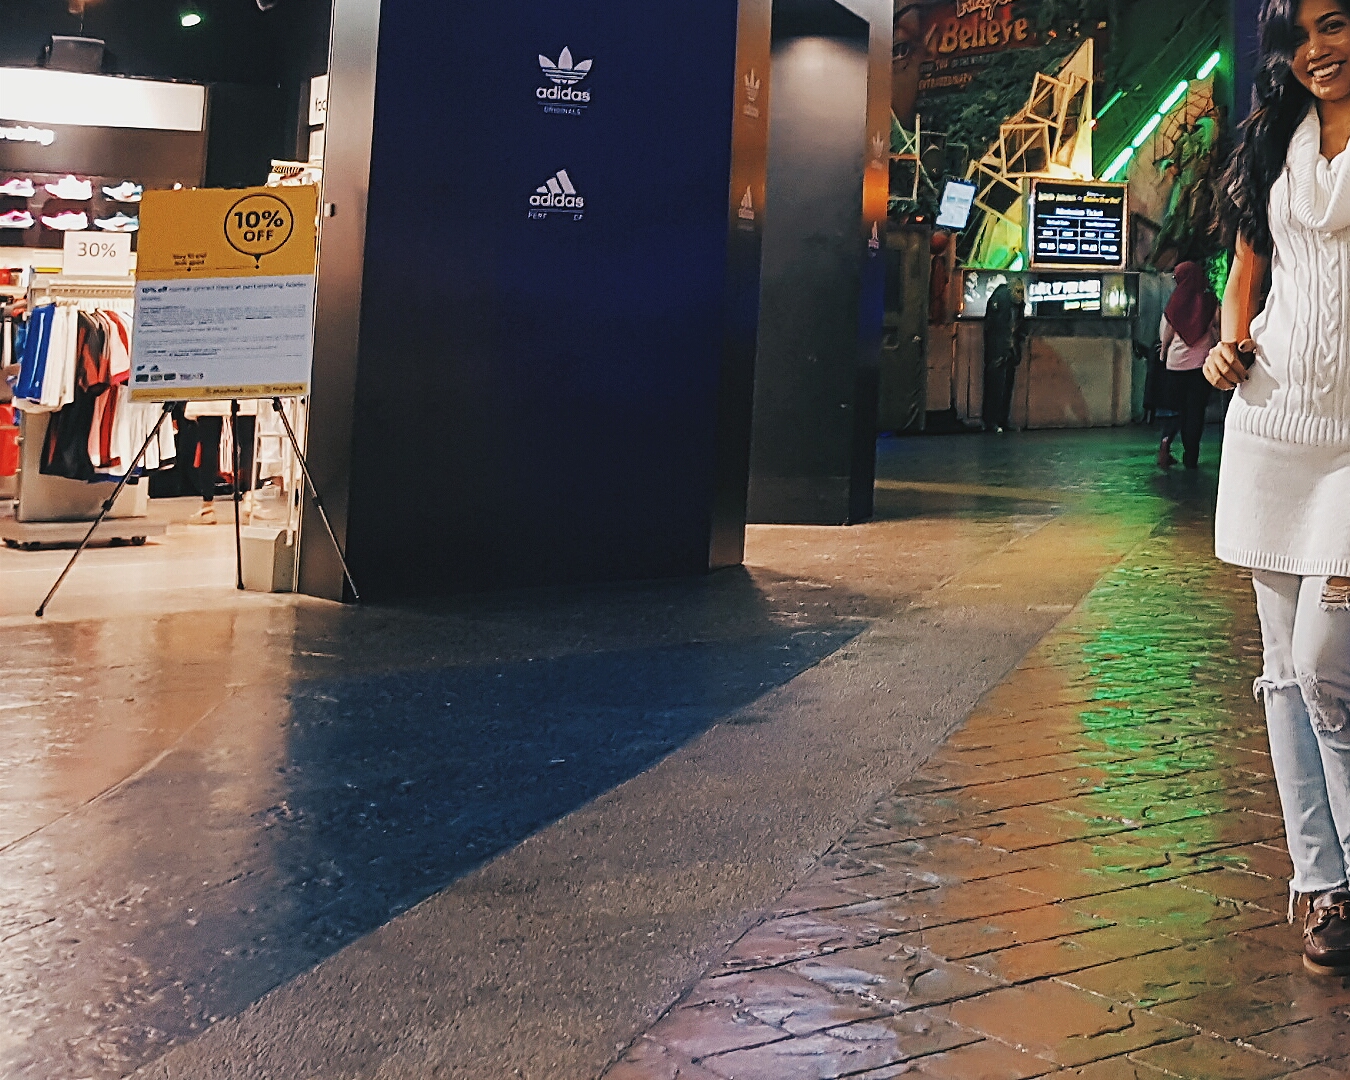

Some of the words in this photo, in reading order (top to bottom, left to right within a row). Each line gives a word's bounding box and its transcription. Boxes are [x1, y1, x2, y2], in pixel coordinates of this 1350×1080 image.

[536, 86, 591, 103] adidas
[529, 193, 585, 208] adidas
[233, 209, 285, 230] 10%
[243, 229, 275, 243] OFF
[76, 241, 117, 259] 30%
